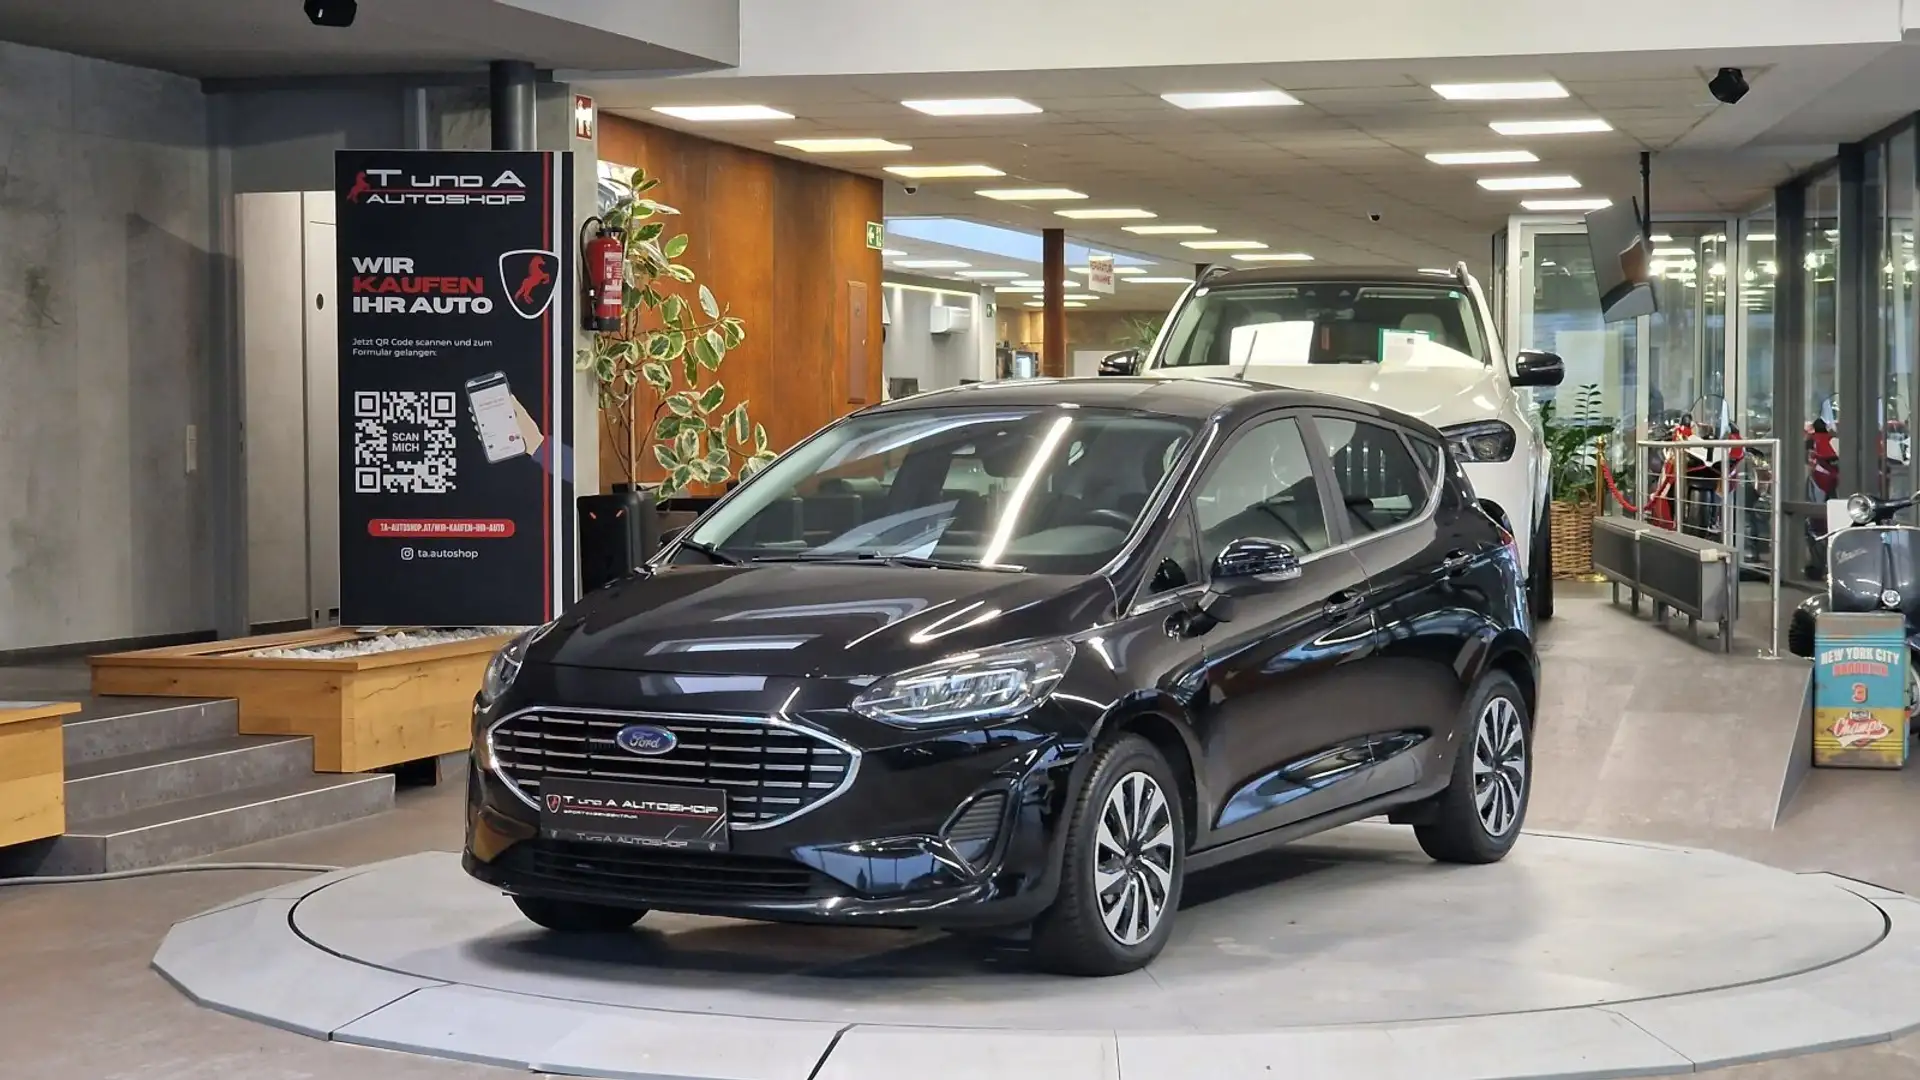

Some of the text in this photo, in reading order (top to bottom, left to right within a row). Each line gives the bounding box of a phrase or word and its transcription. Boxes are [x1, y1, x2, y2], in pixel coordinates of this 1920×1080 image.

[366, 169, 402, 187] T
[491, 170, 526, 188] A
[366, 194, 526, 205] AUTOSHOP
[352, 257, 414, 274] WIR
[353, 276, 484, 294] KAUFEN
[353, 297, 493, 314] IHR AUTO
[352, 338, 374, 346] Jetzt
[375, 338, 389, 347] QR
[391, 338, 414, 346] Code
[454, 338, 472, 347] und
[352, 348, 392, 356] Formular
[392, 433, 420, 442] SCAN
[392, 443, 420, 452] MICH
[417, 549, 479, 560] ta.autoshop
[1820, 646, 1900, 665] NEW YORK CITY
[629, 731, 661, 749] Ford
[562, 795, 575, 804] T
[606, 799, 618, 807] A
[621, 800, 719, 815] AUTOSHOP
[616, 836, 688, 849] AUTOSHOP
